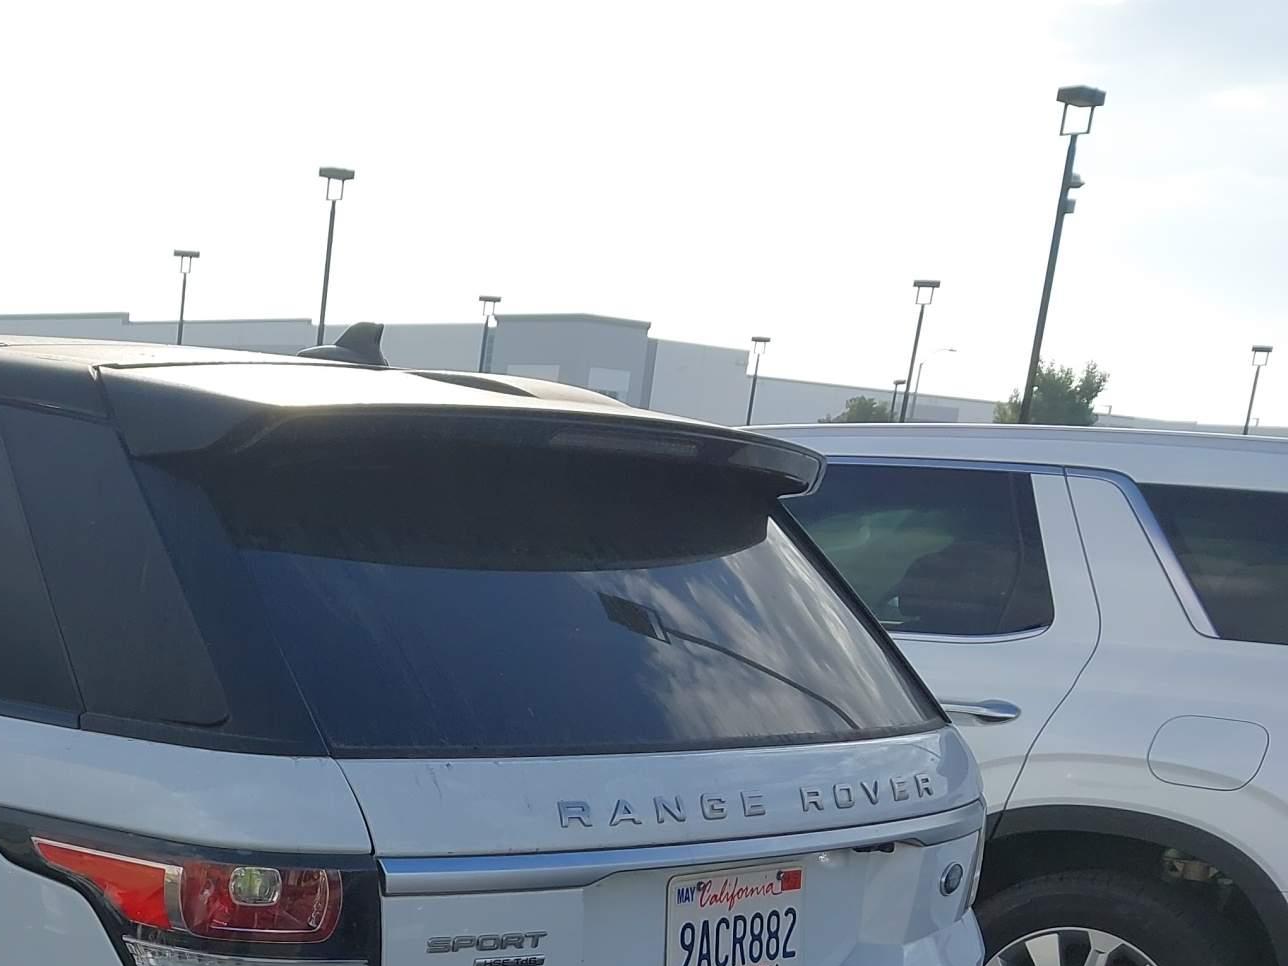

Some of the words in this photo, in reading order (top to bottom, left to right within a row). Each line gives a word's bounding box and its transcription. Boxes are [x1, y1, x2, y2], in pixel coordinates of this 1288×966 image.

[557, 788, 767, 829] RANGE
[798, 772, 935, 813] ROVER
[676, 886, 696, 905] MAY
[698, 876, 782, 911] California
[425, 930, 549, 954] SPORT
